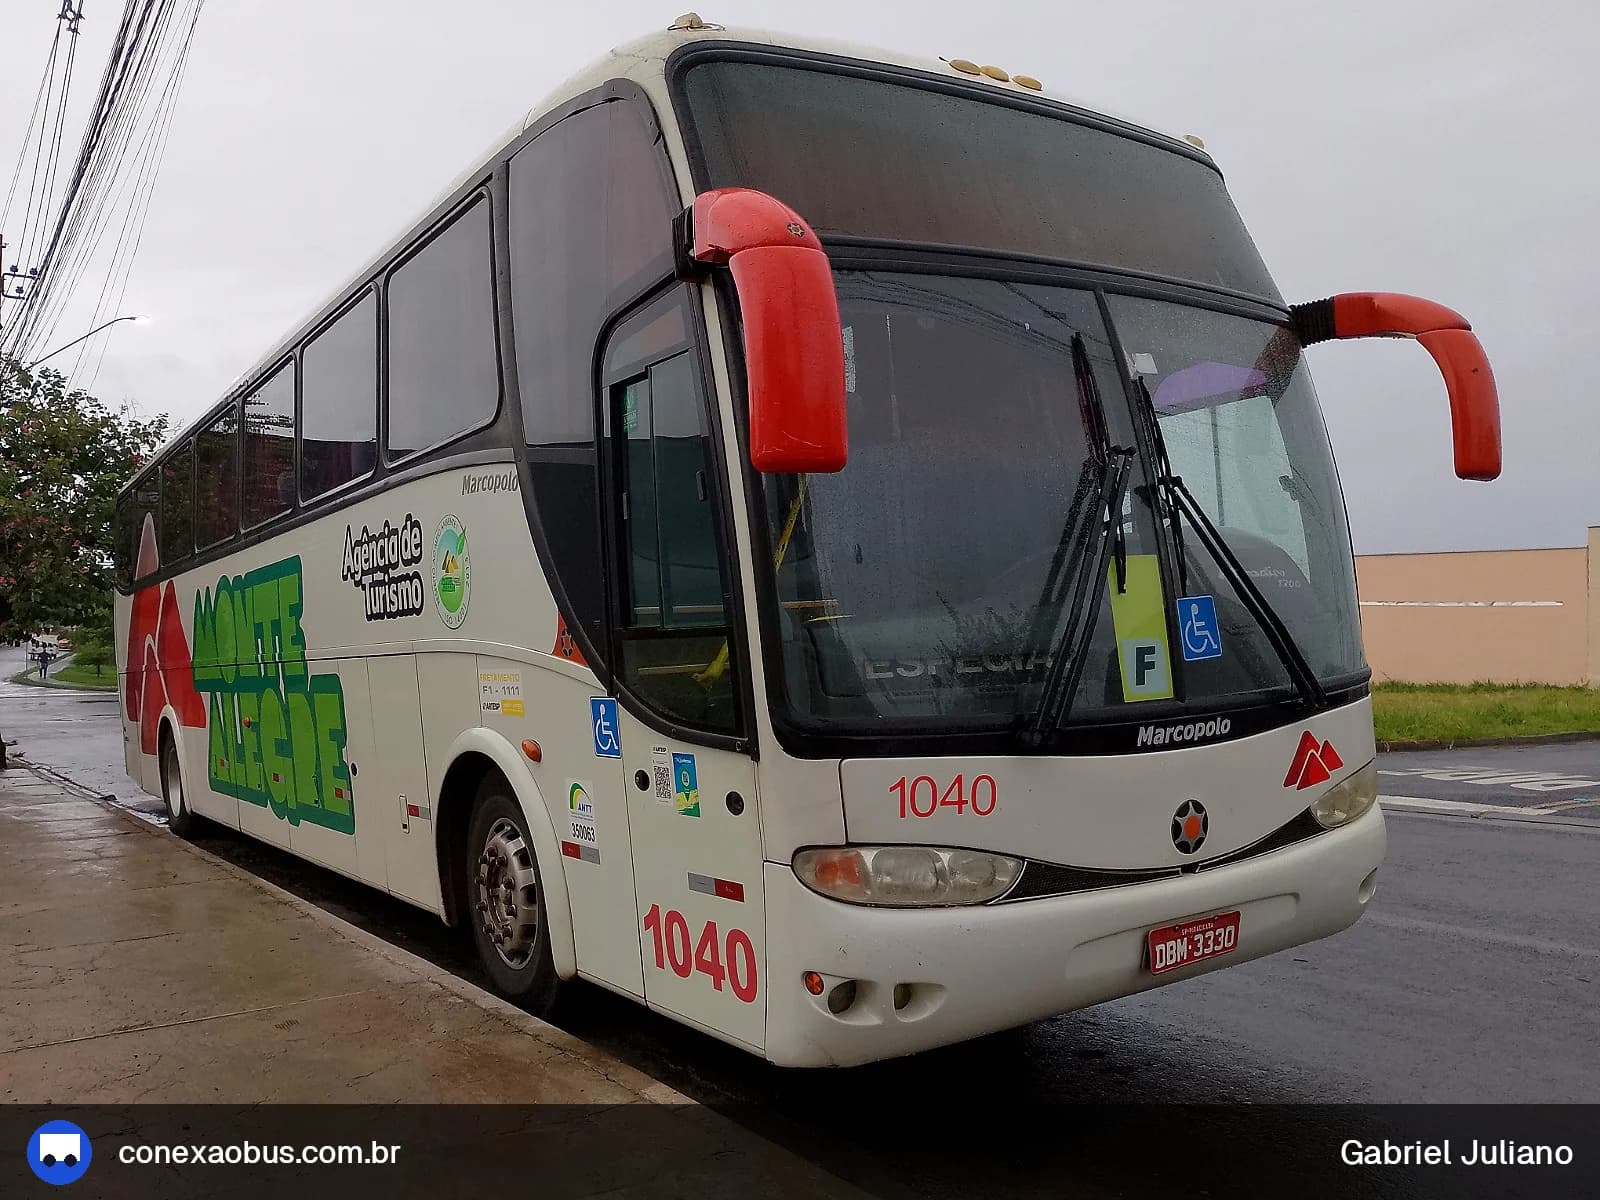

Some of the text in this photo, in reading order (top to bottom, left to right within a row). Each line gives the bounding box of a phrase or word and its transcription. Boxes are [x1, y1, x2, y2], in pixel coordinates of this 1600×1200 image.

[461, 470, 518, 495] Marcopolo
[342, 515, 422, 582] Agência de
[361, 572, 424, 620] Turismo
[193, 560, 307, 689] MONTE
[1135, 645, 1156, 686] F
[482, 685, 493, 695] F1
[501, 685, 520, 696] 1111
[209, 678, 354, 828] ALEGRE
[1137, 718, 1231, 746] Marcopolo
[577, 802, 593, 813] ANTT
[889, 773, 998, 819] 1040
[571, 822, 596, 842] 350063
[643, 903, 758, 1003] 1040
